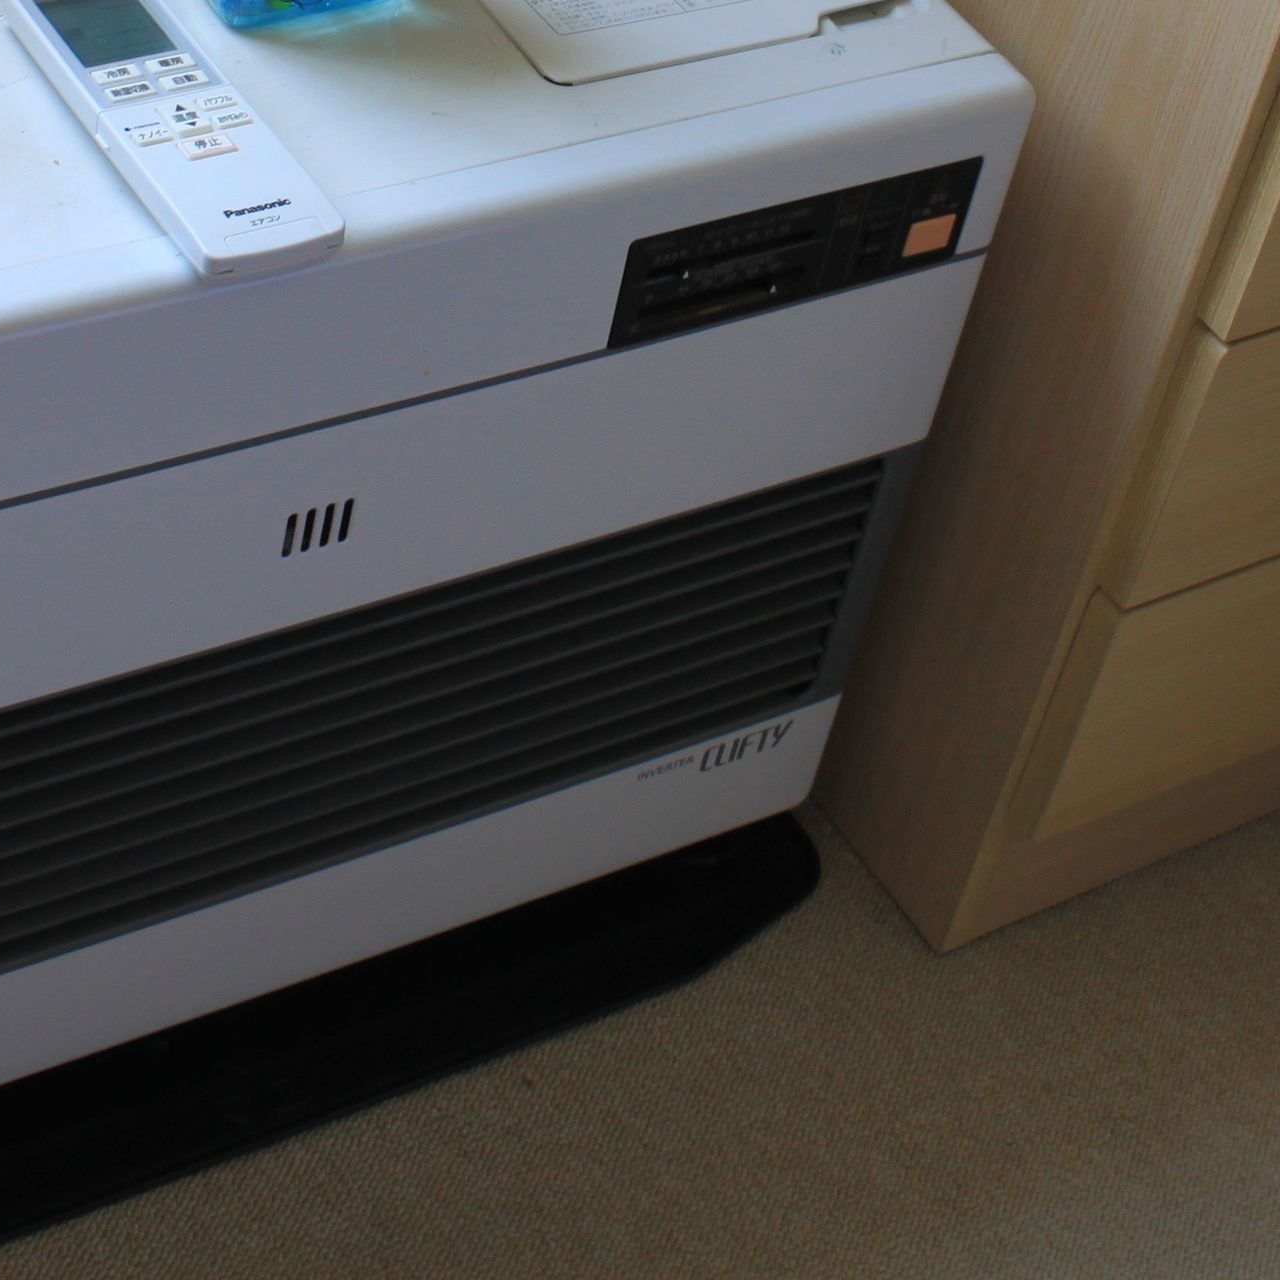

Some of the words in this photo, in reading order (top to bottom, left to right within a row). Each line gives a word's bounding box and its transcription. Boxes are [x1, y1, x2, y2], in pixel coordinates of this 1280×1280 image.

[105, 67, 130, 79] 冷房
[172, 73, 198, 85] 自動
[195, 138, 222, 149] 停止
[223, 198, 292, 219] Panasonic
[637, 756, 694, 781] INVERTER
[698, 718, 795, 773] CLIFTY
